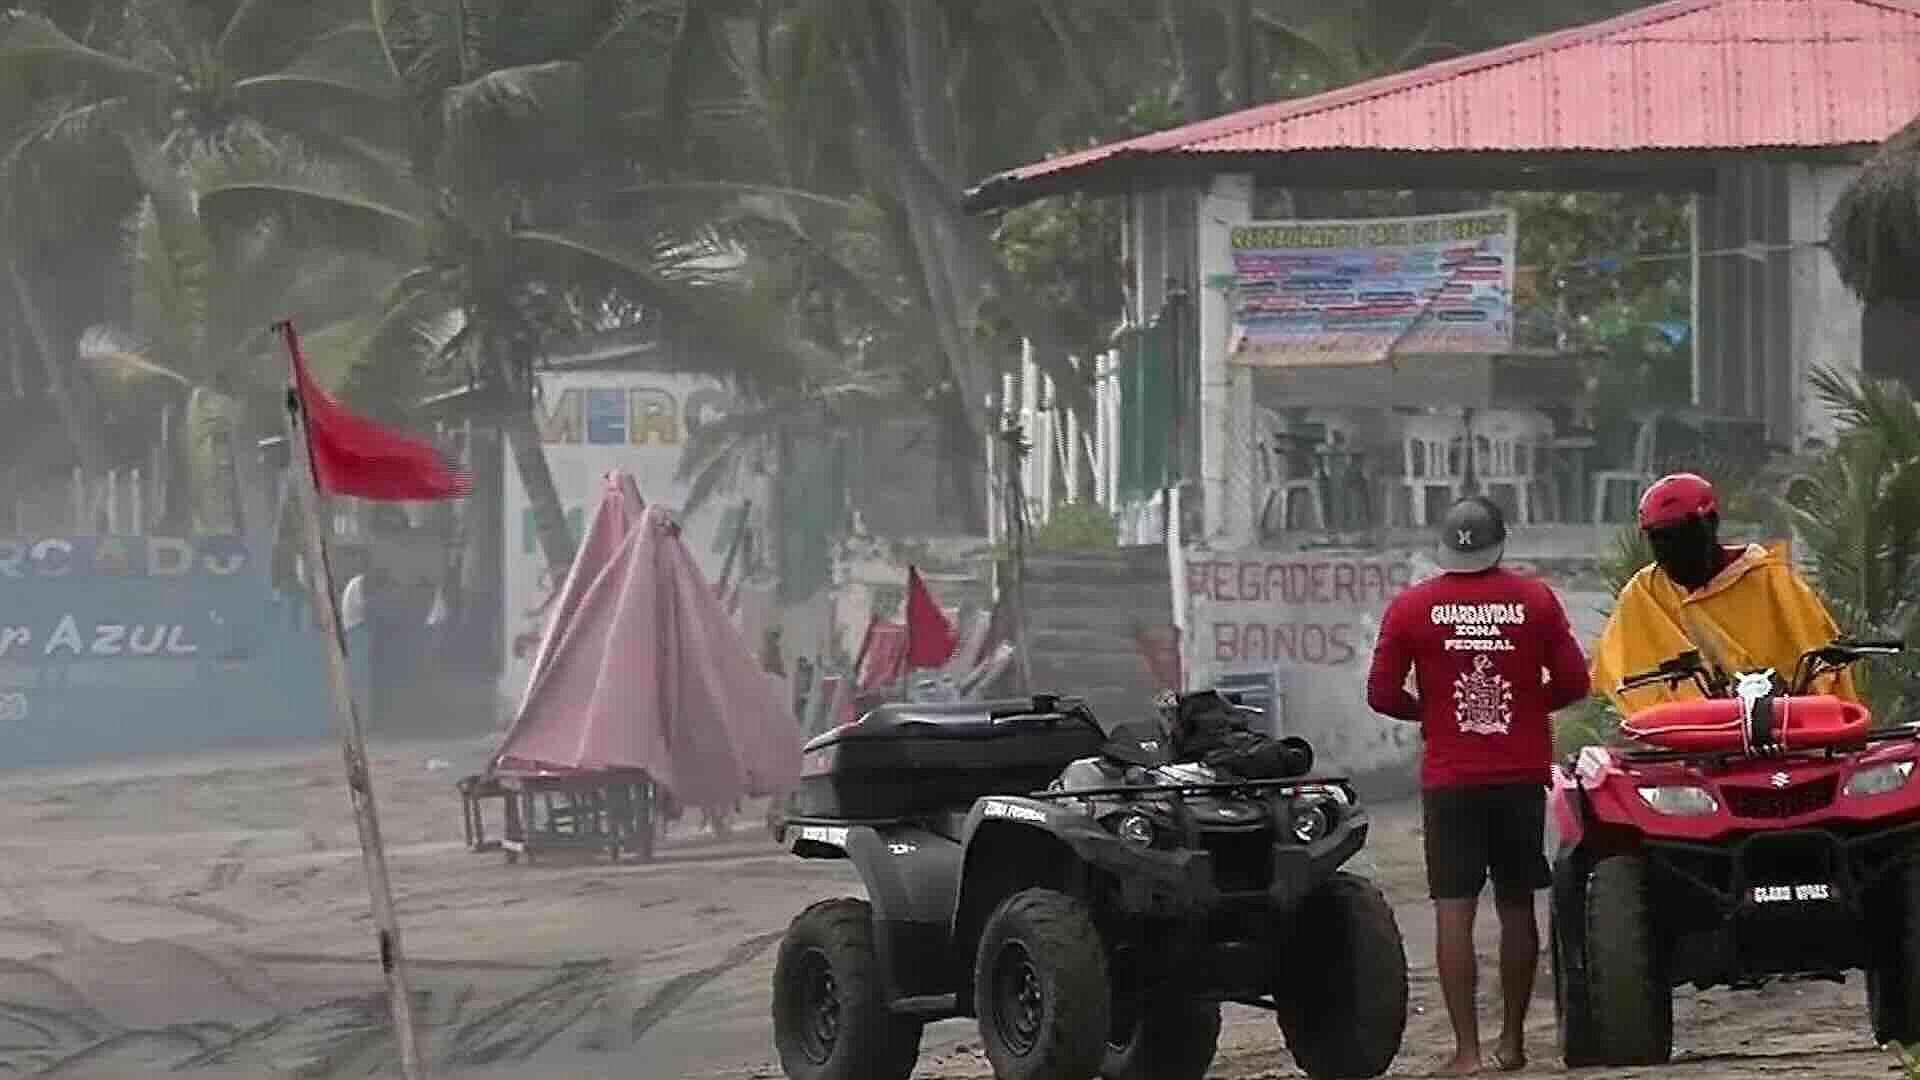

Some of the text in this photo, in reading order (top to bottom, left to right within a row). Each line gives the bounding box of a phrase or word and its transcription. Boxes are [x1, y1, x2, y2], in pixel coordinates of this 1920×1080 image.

[1430, 604, 1525, 624] GUARDAVIDAS
[1455, 624, 1501, 636] ZONA
[1444, 639, 1516, 651] FEDERAL
